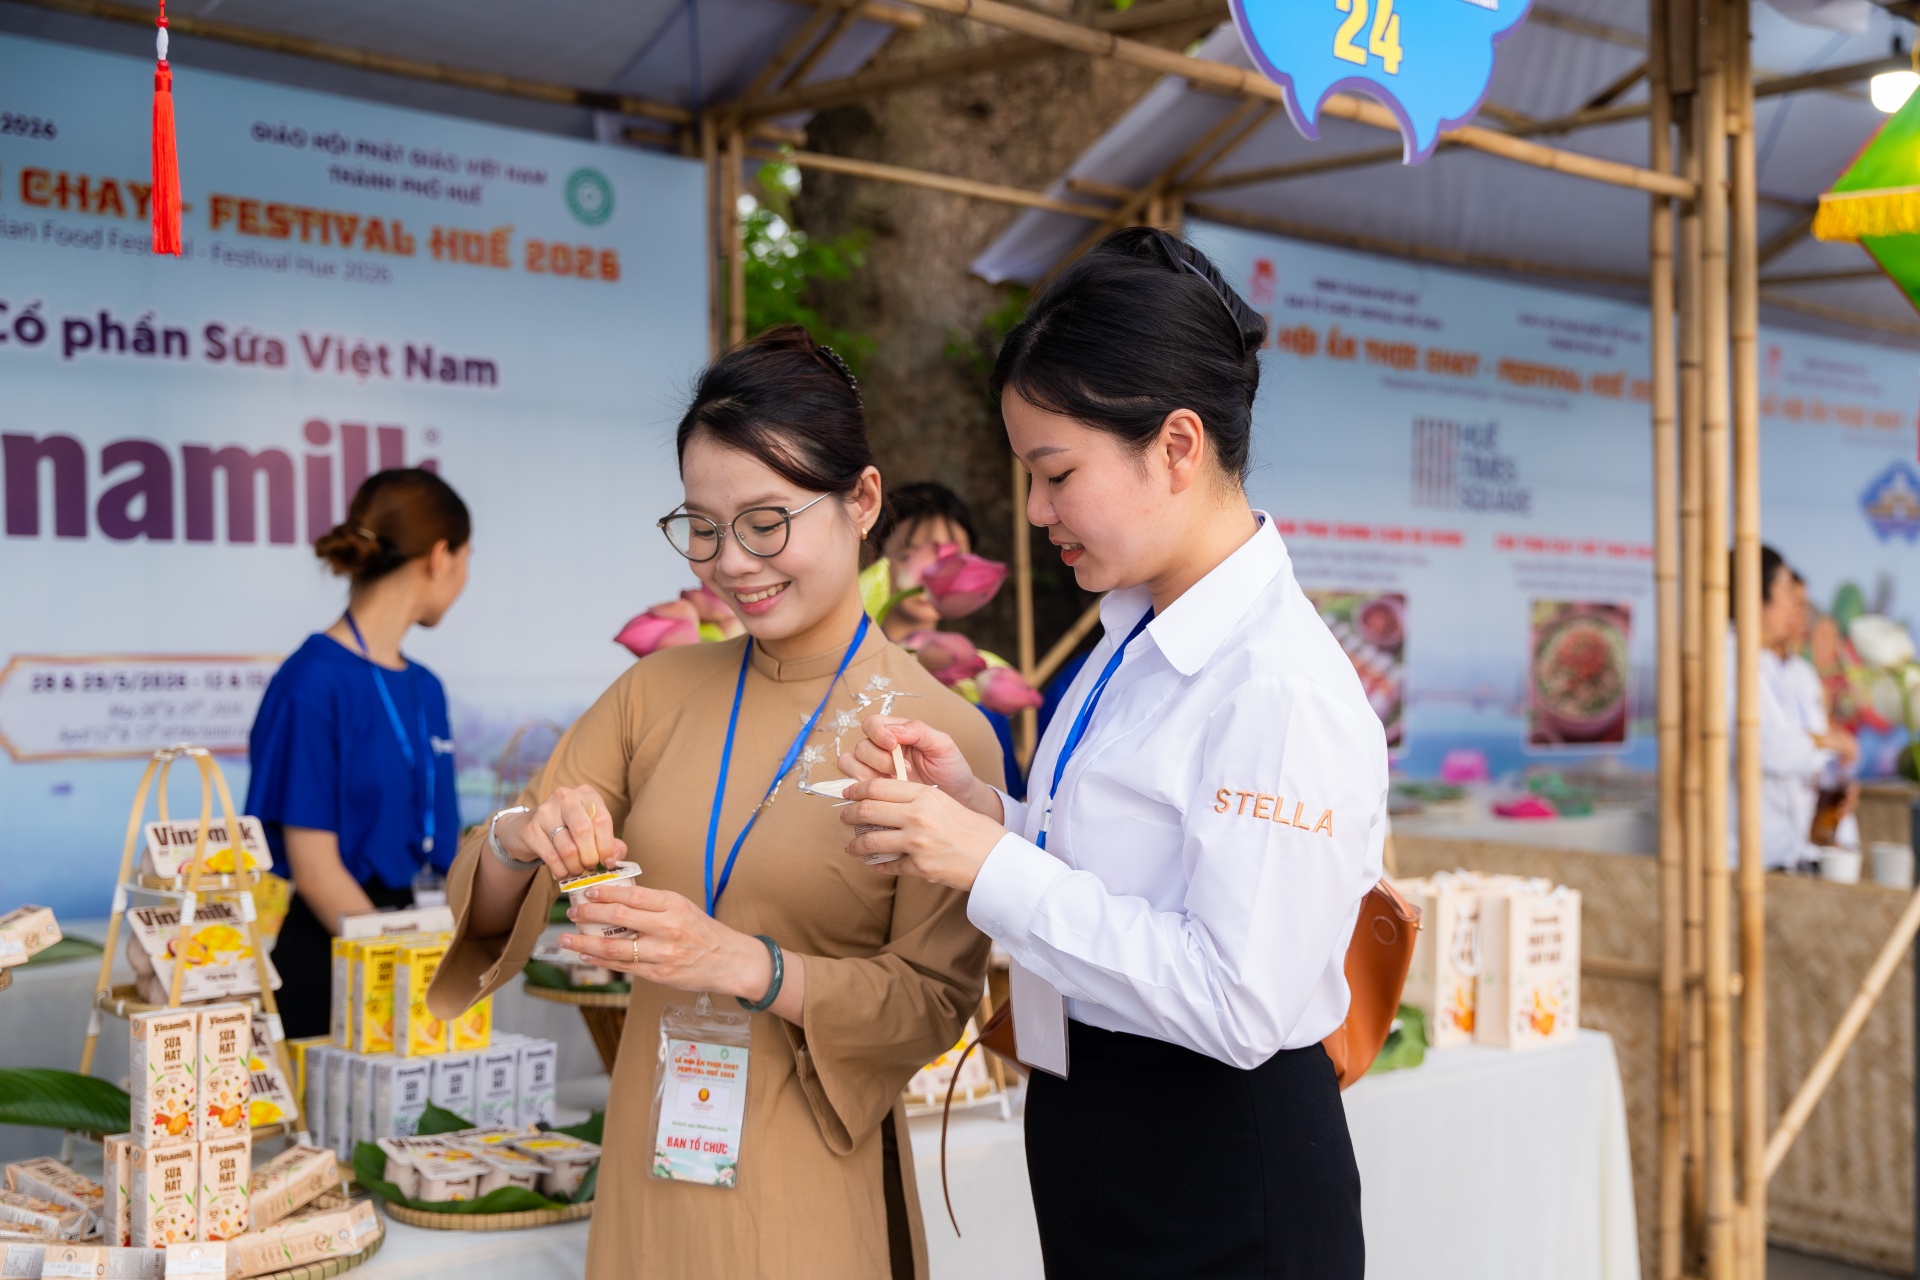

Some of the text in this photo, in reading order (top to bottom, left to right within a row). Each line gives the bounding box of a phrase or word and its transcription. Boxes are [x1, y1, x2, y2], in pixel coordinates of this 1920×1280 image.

[1333, 0, 1403, 75] 24
[251, 120, 308, 150] GIÁO
[409, 147, 461, 172] GIÁO
[20, 166, 153, 220] CHAY
[209, 193, 415, 257] FESTIVAL
[428, 223, 514, 269] HUẾ
[525, 238, 620, 281] 2026
[42, 220, 103, 252] Food
[211, 241, 291, 271] Festival
[299, 333, 391, 384] Việt
[405, 344, 498, 386] Nam
[1213, 787, 1333, 837] STELLA
[154, 1020, 192, 1032] Vinamilk
[208, 1013, 246, 1025] Vinamilk
[154, 1150, 192, 1163] Vinamilk
[208, 1142, 246, 1154] Vinamilk
[667, 1136, 687, 1149] BAN
[703, 1140, 728, 1154] CHỨC
